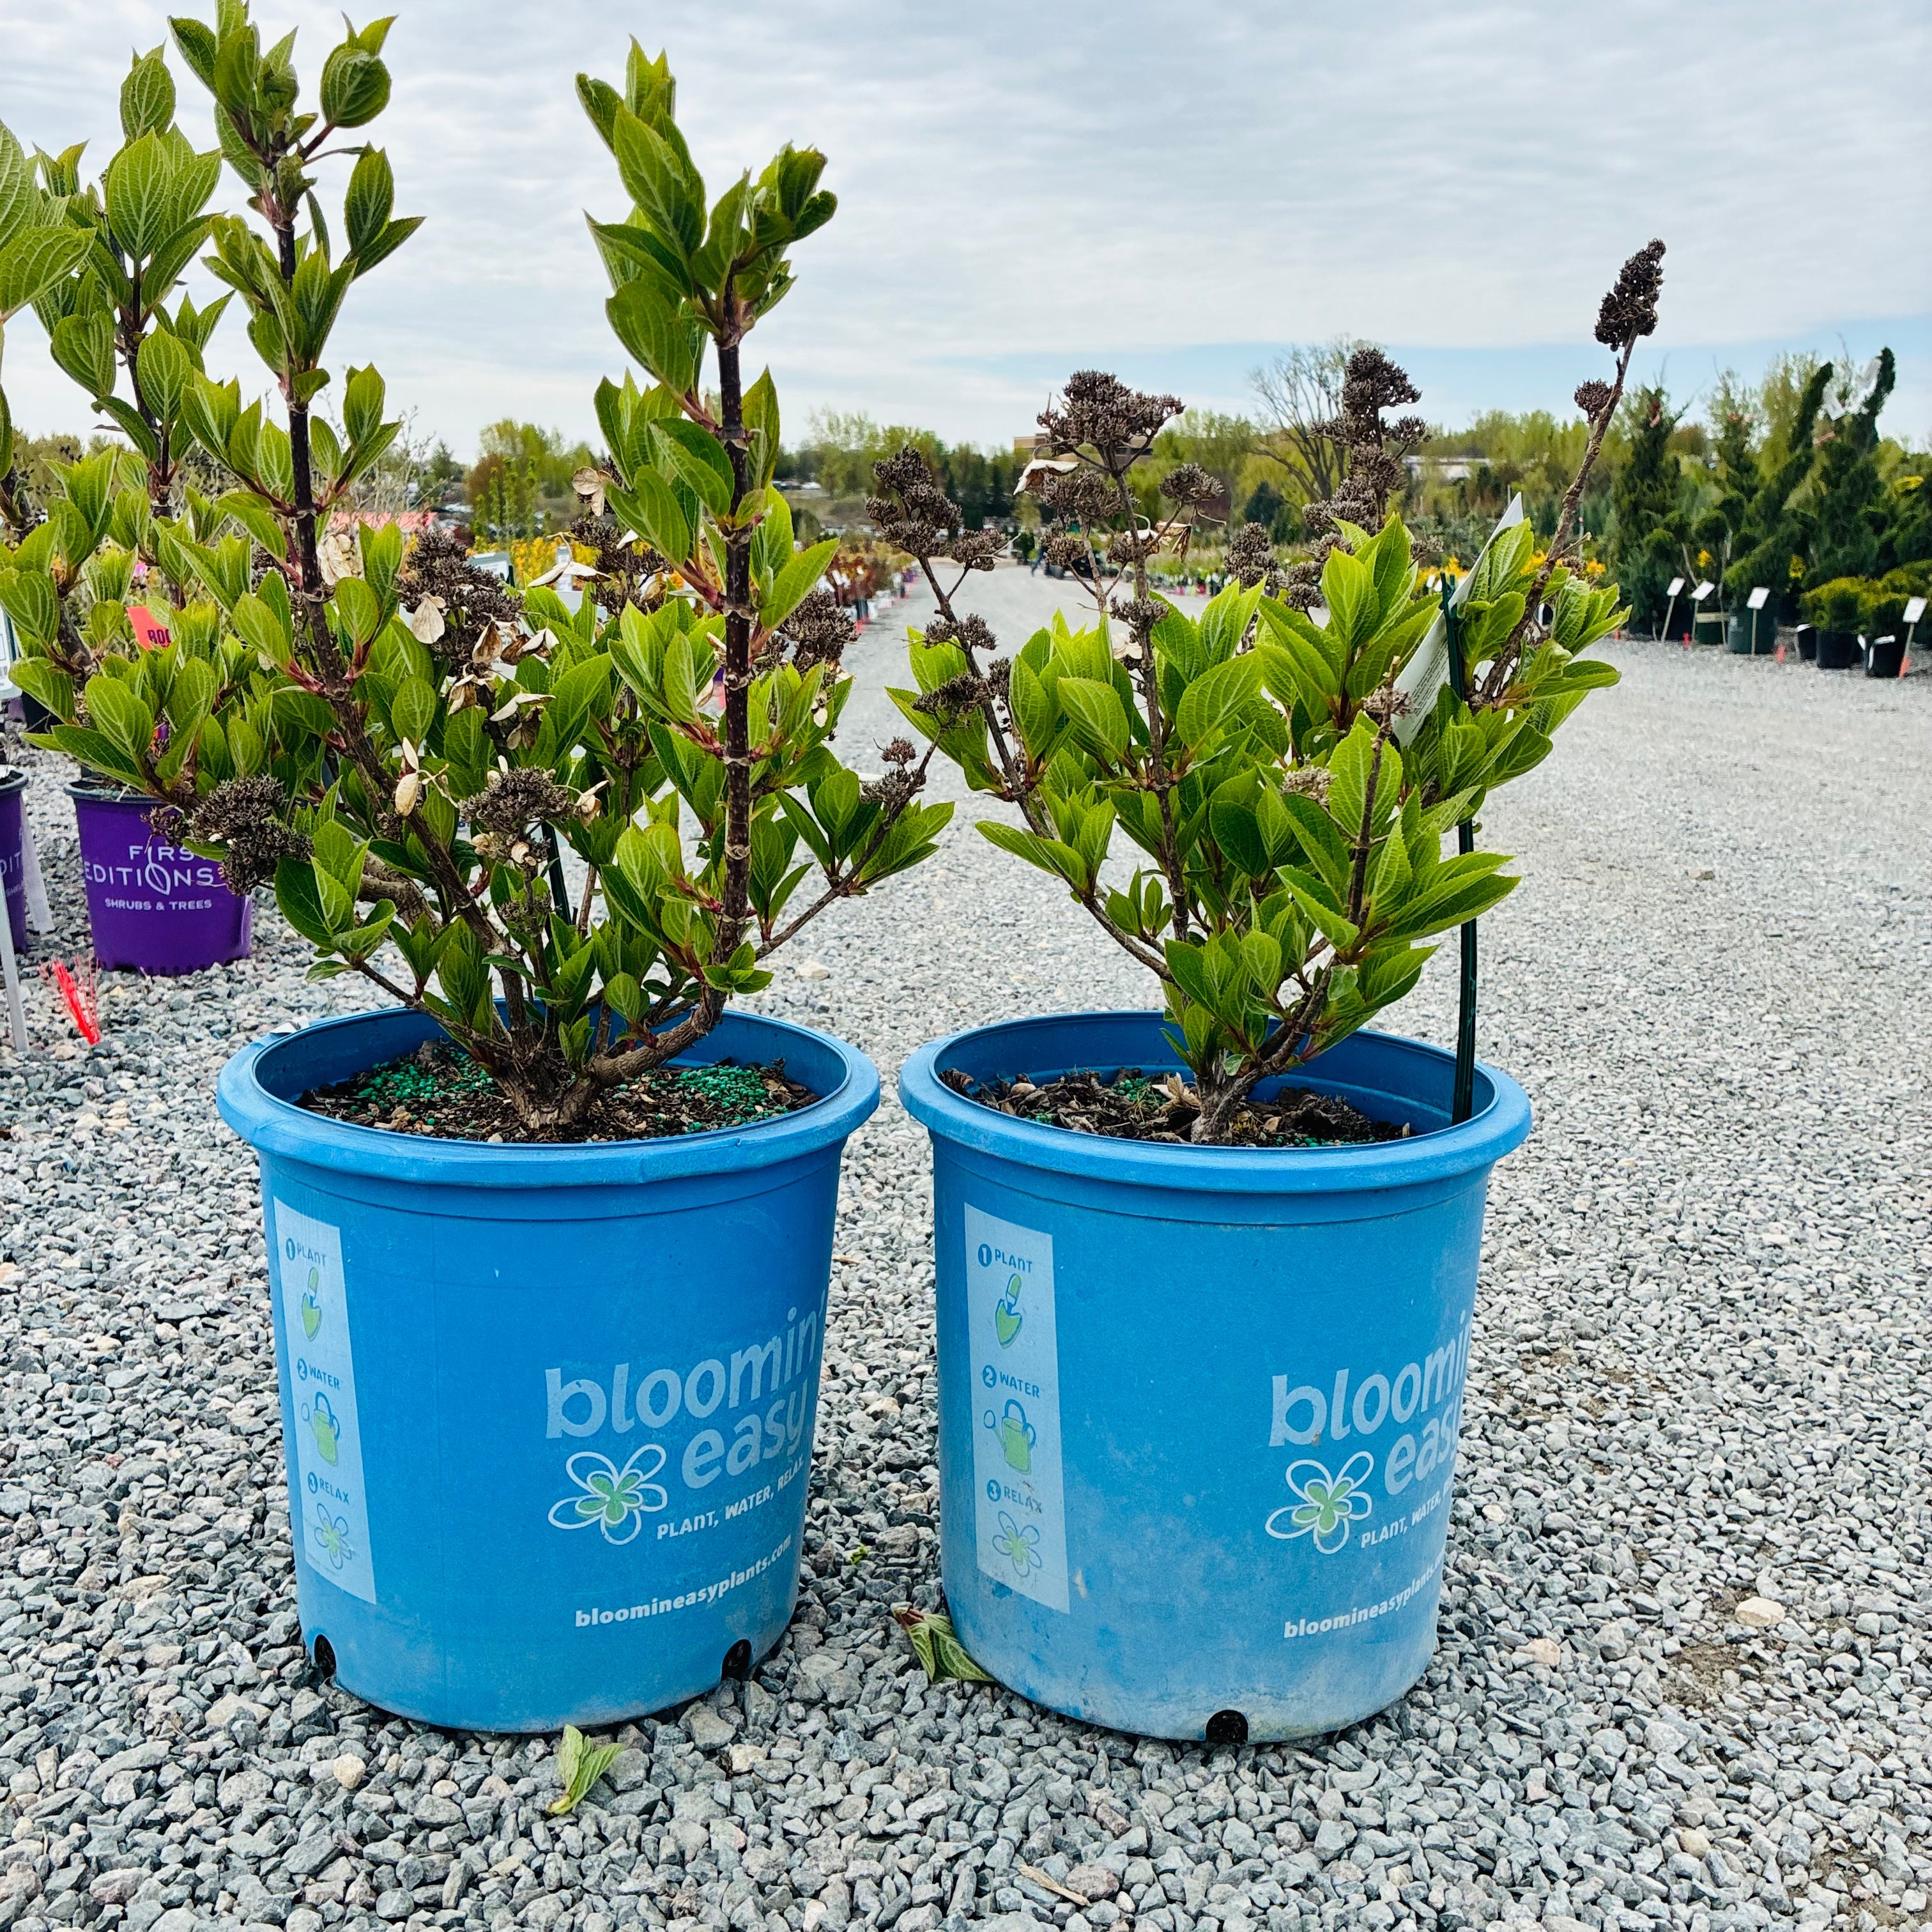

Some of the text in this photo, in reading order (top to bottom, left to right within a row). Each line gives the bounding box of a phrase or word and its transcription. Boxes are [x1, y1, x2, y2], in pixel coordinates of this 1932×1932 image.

[129, 845, 207, 862] FIRS
[84, 861, 214, 896] EDITIONS
[105, 898, 212, 911] SHRUBS & TREES
[297, 1243, 326, 1267] PLANT
[995, 1248, 1032, 1273] PLANT
[309, 1364, 341, 1391] WATER
[1000, 1370, 1040, 1399] WATER
[681, 1378, 808, 1489] easy
[319, 1478, 349, 1505] RELAX
[725, 1483, 774, 1519] WATER,
[1004, 1486, 1042, 1514] RELAX
[575, 1534, 792, 1627] bloomineasyplants.com
